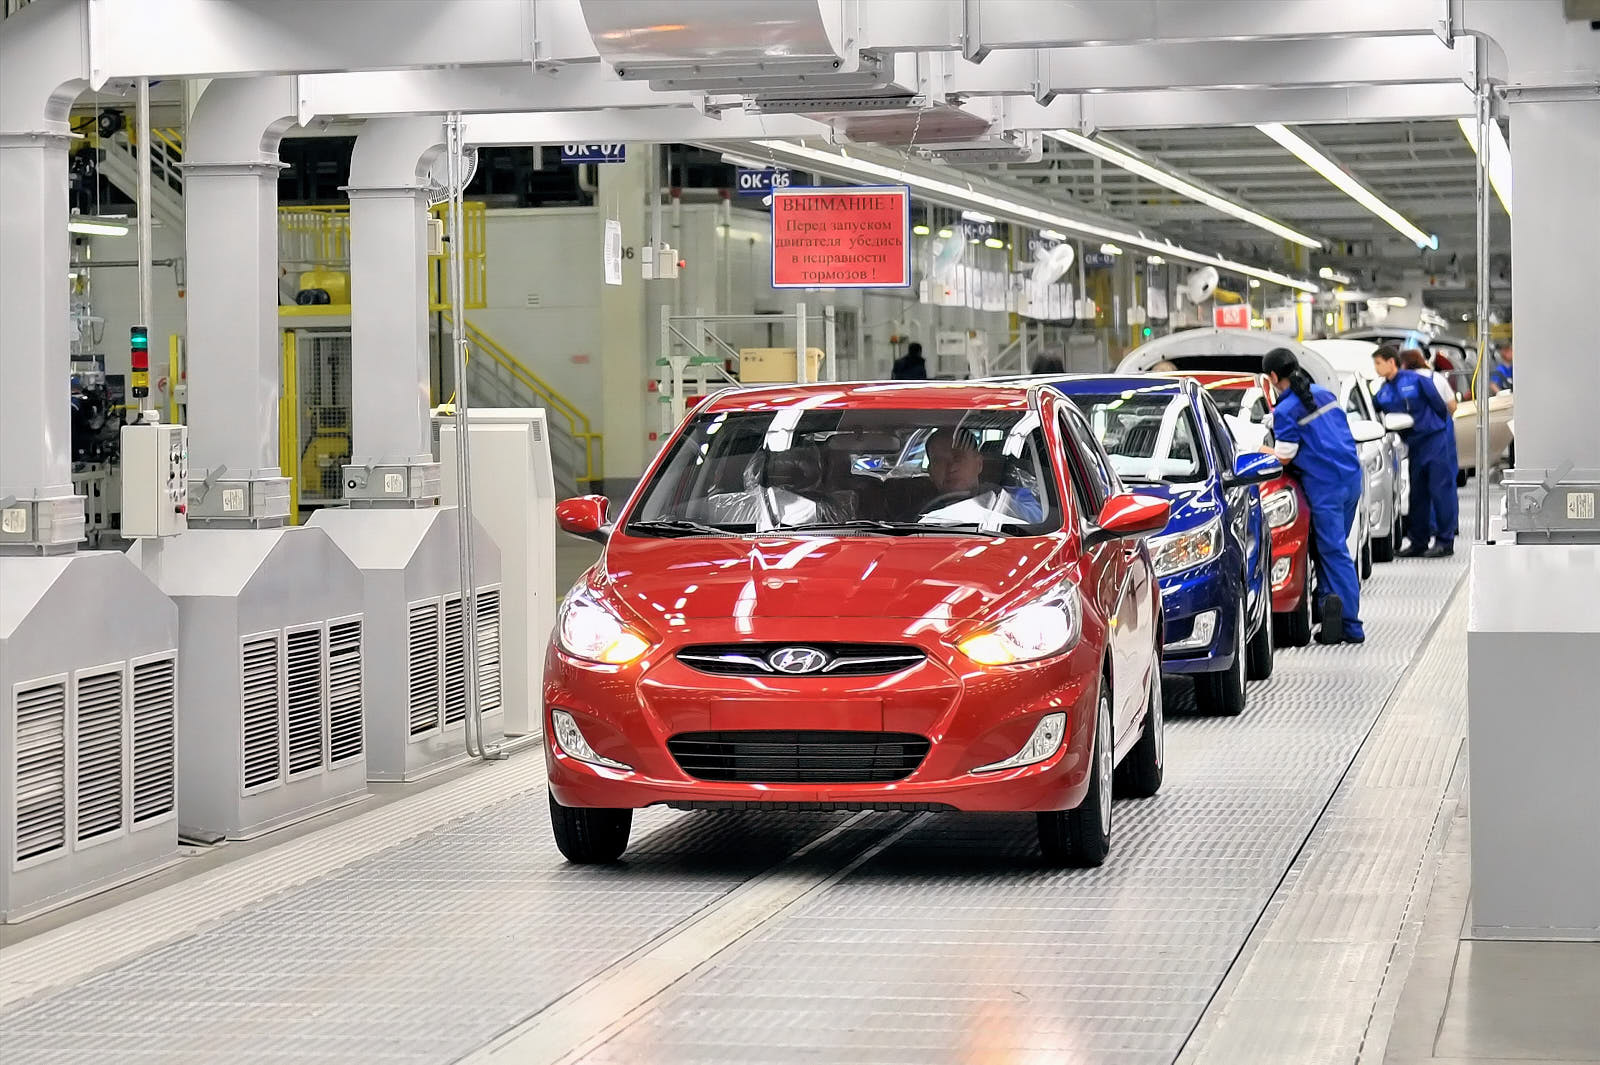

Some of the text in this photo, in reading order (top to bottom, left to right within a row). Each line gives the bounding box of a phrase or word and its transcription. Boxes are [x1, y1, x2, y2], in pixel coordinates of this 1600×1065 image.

[564, 143, 623, 156] OK-07
[740, 173, 790, 188] OK-06
[783, 197, 886, 211] ВНИМАНИЕ
[786, 219, 892, 234] Перед запуском
[775, 234, 903, 249] двигателя убедись
[791, 254, 887, 266] в исправности
[801, 270, 868, 283] тормозов
